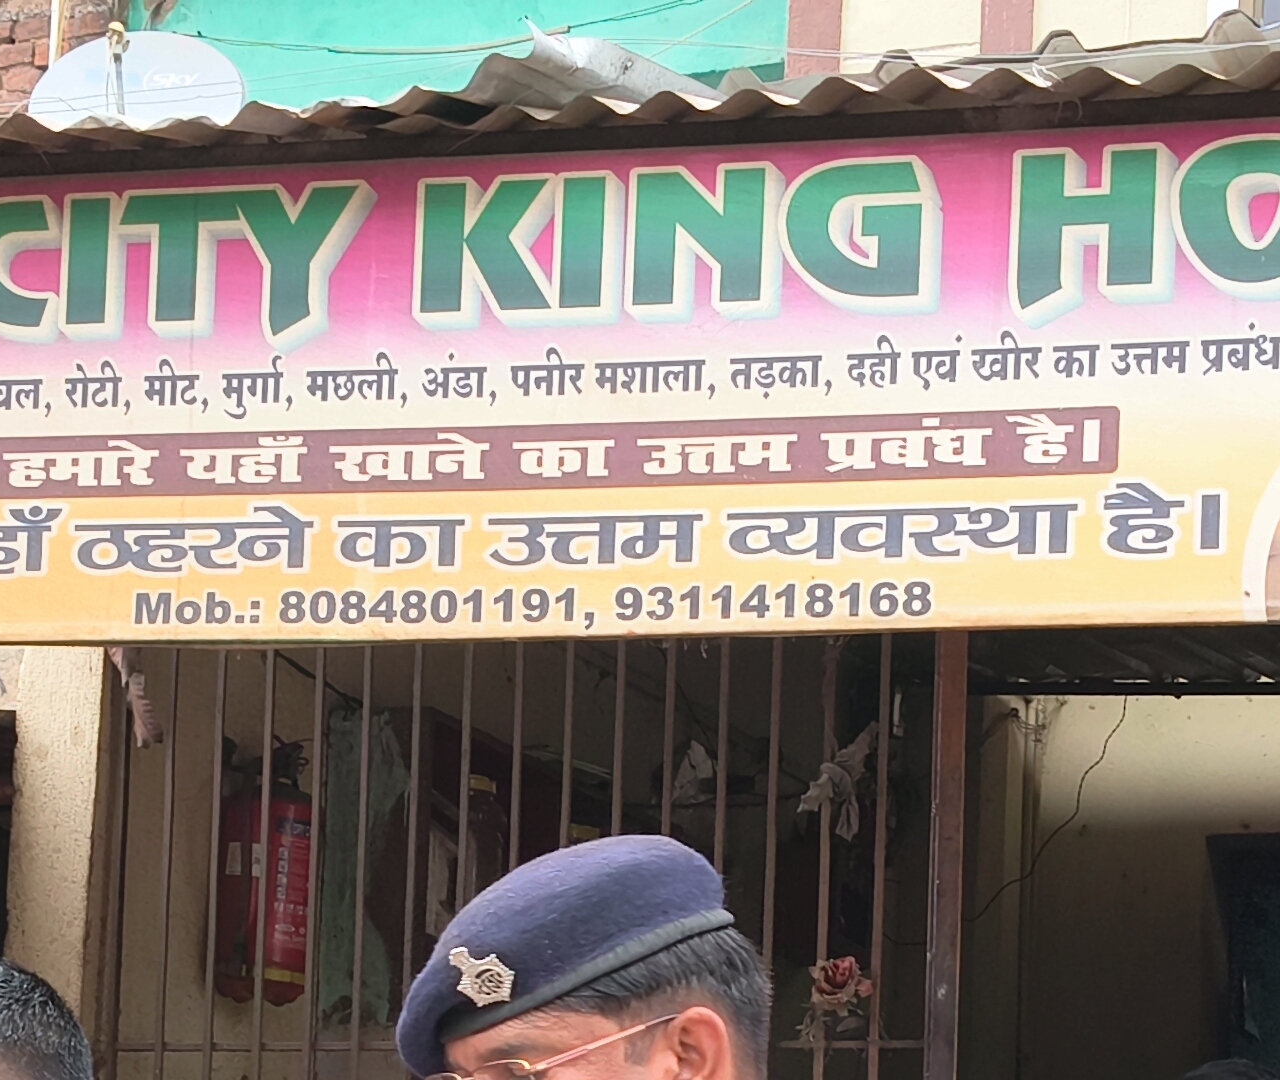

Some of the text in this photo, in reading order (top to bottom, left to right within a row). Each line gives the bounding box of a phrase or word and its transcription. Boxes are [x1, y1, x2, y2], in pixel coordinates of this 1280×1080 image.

[417, 157, 932, 318] KING
[65, 360, 131, 415] रोटी,
[144, 358, 209, 413] मीट,
[222, 355, 293, 419] मुर्गा,
[306, 351, 408, 408] मछली,
[421, 353, 497, 405] अंडा,
[511, 347, 585, 396] पनीर
[595, 359, 717, 400] मशाला,
[730, 355, 833, 399] तड़का,
[847, 335, 901, 388] दही
[912, 334, 963, 391] एवं
[971, 330, 1042, 380] खीर
[1053, 345, 1100, 378] का
[1111, 341, 1190, 375] उत्तम
[2, 415, 1100, 488] हमारे यहाँ खाने का उत्तम प्रबंध है।
[74, 506, 315, 573] ठहरने
[337, 516, 466, 568] का
[487, 513, 704, 567] उत्तम
[726, 502, 1079, 561] व्यवस्था
[1103, 482, 1222, 556] है।
[134, 580, 933, 630] Mob.: 8084801191, 9311418168
